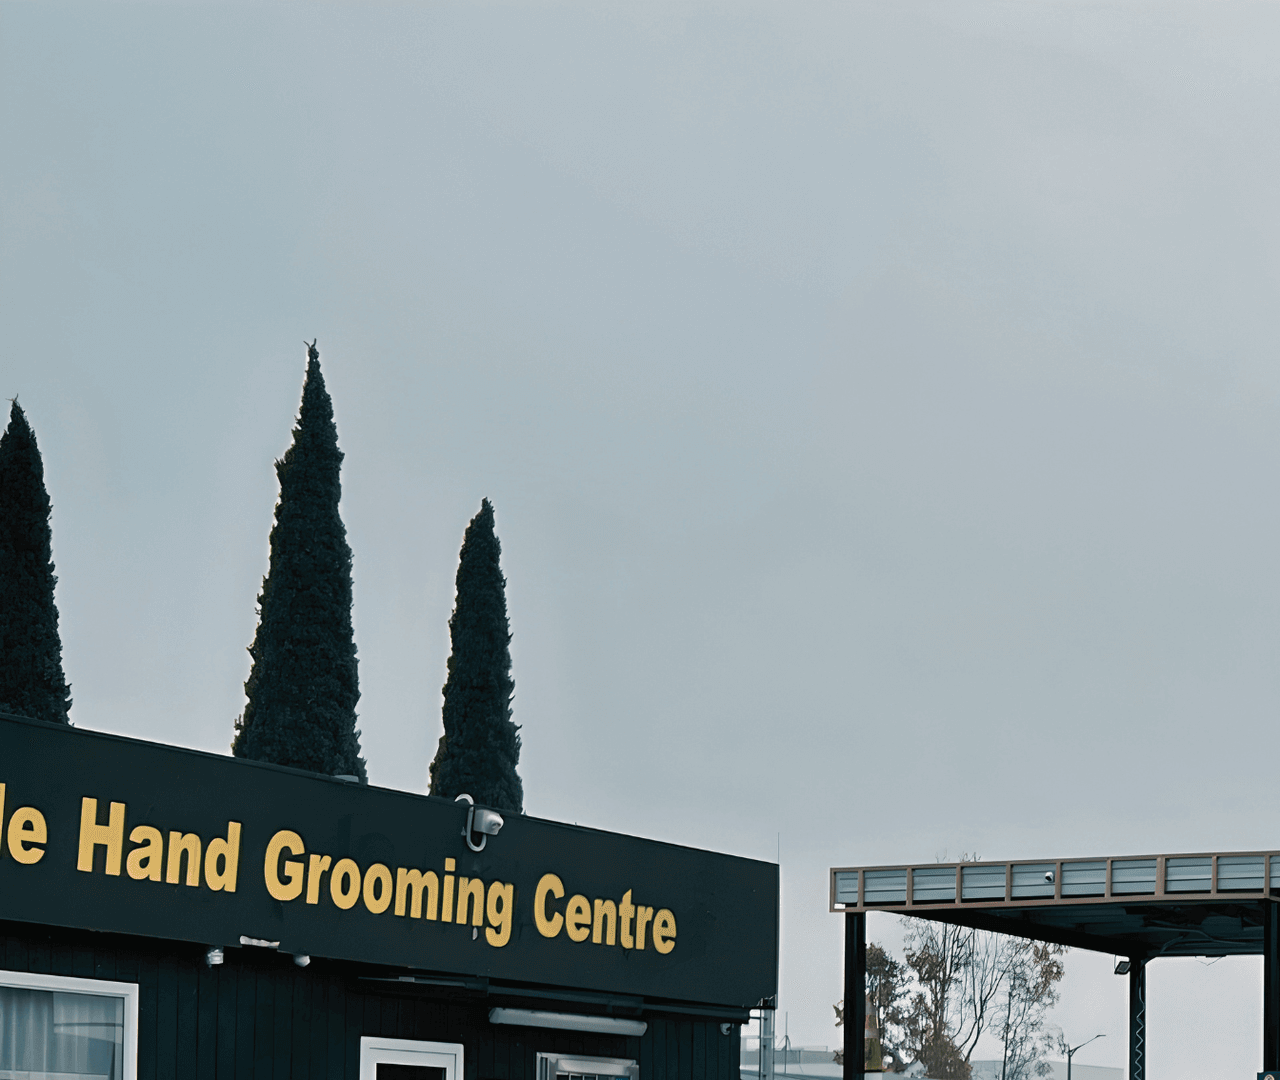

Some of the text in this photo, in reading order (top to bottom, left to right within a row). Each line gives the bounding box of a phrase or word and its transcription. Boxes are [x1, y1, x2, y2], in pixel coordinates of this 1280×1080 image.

[76, 797, 242, 893] Hand
[263, 829, 515, 948] Grooming
[533, 872, 678, 955] Centre
